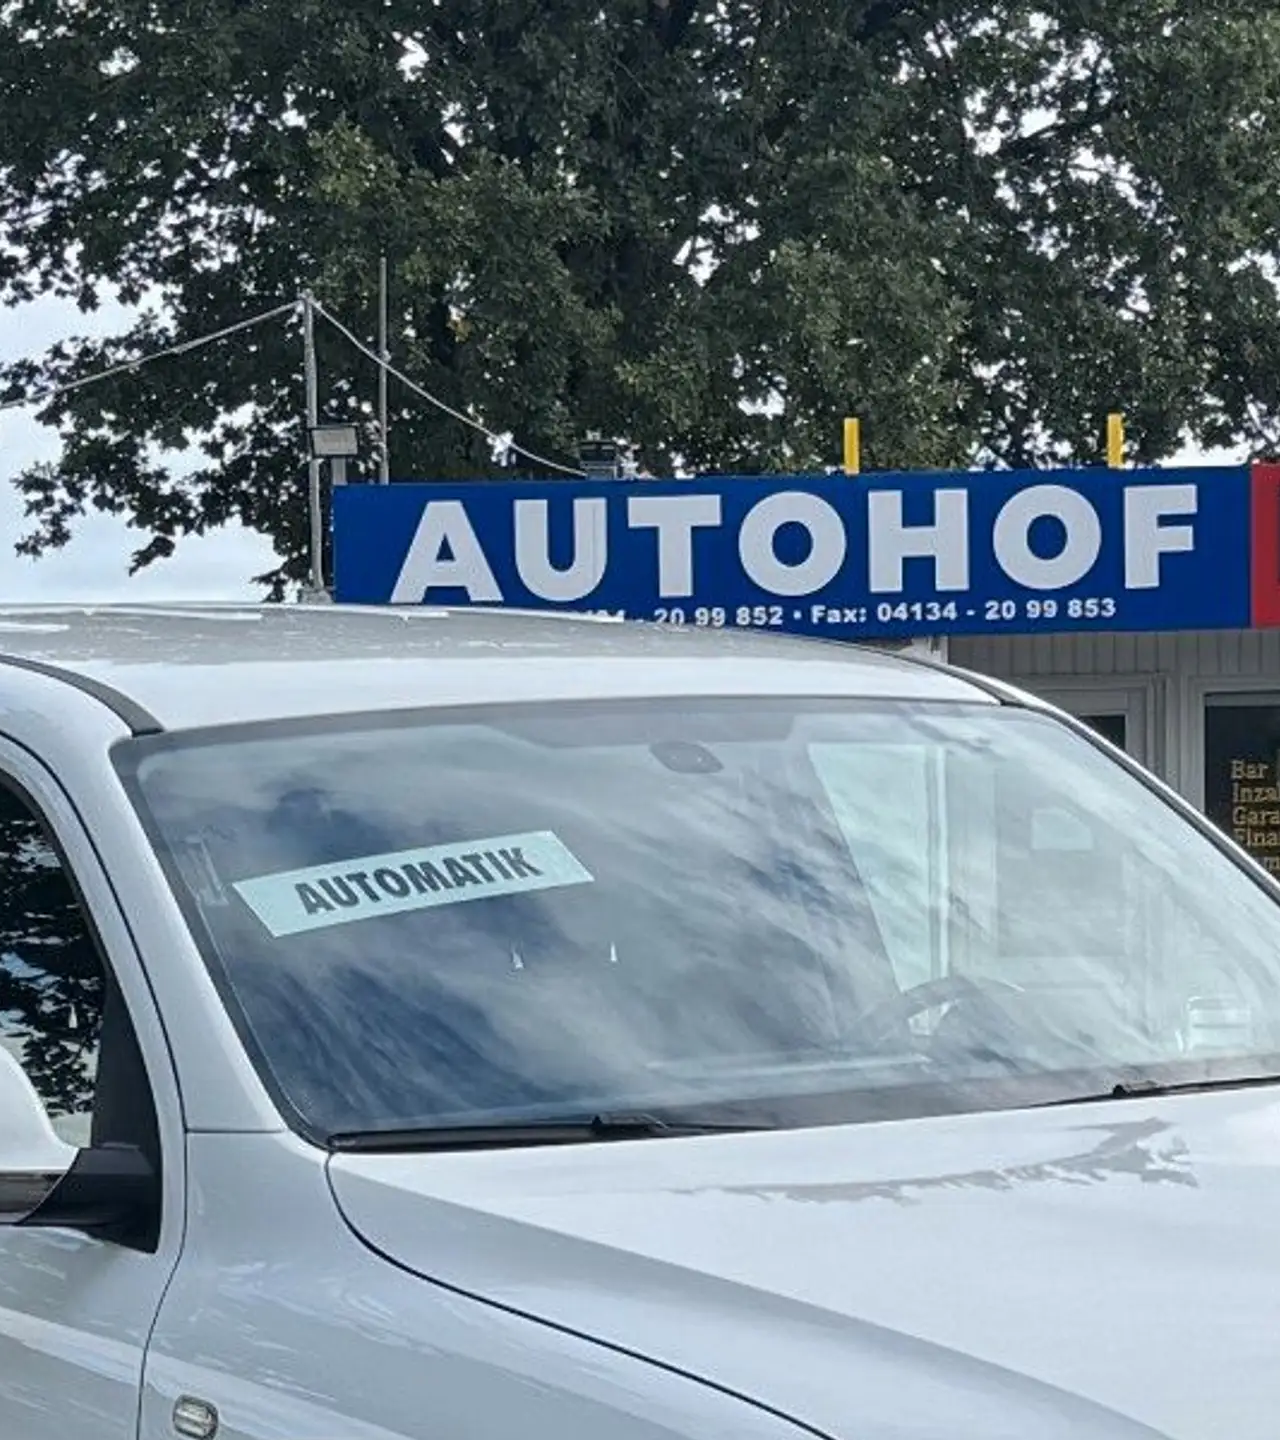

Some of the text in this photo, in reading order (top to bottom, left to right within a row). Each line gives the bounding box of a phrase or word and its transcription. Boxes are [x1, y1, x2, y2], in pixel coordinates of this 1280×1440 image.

[391, 484, 1198, 603] AUTOHOF
[736, 606, 784, 625] 852
[811, 605, 867, 624] Fax:
[877, 602, 959, 622] 04134
[985, 600, 1016, 620] 20
[1026, 599, 1058, 619] 99
[1067, 598, 1117, 619] 853
[294, 847, 543, 914] AUTOMATIK
